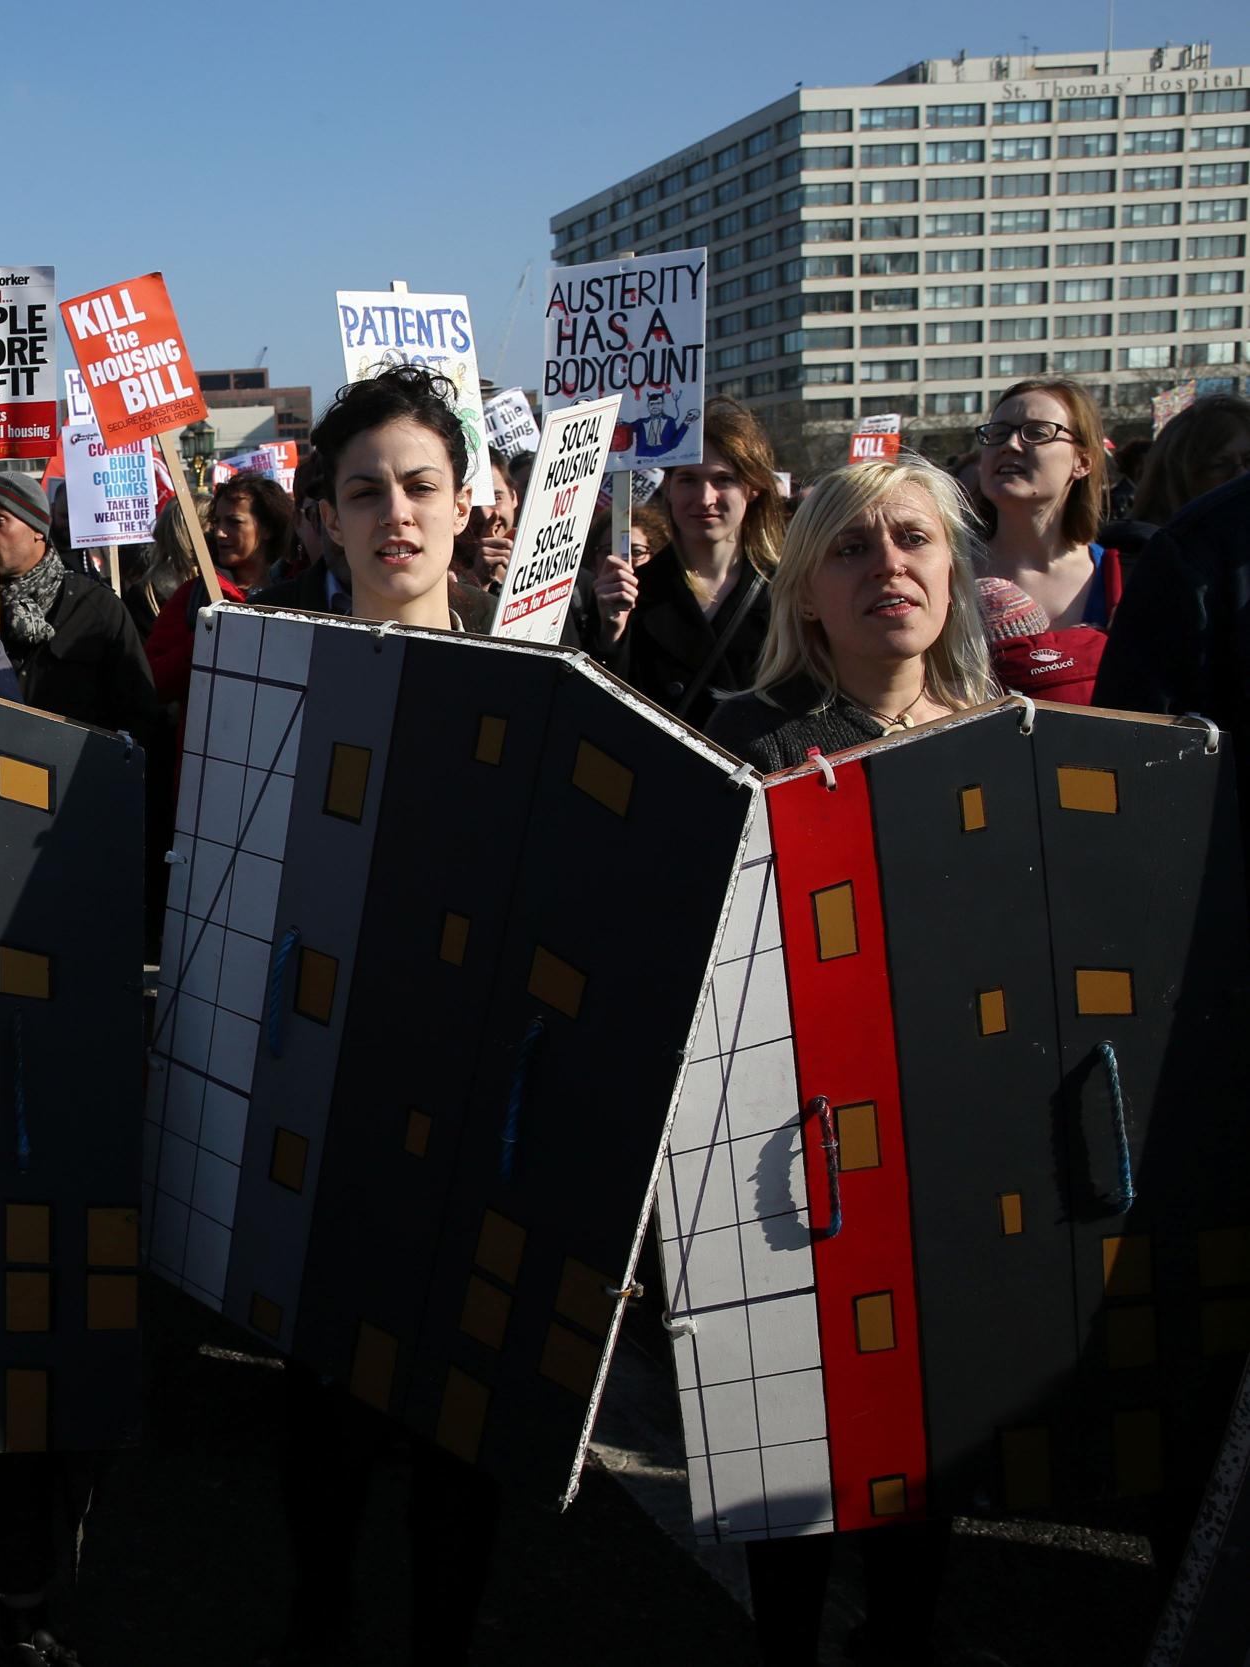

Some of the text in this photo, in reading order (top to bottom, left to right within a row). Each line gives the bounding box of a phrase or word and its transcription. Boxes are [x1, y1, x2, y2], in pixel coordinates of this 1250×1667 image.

[1002, 83, 1027, 99] St.
[1142, 67, 1243, 93] Hospital
[546, 262, 705, 317] AUSTERITY
[69, 289, 146, 340] KILL
[340, 304, 471, 353] PATIENTS
[106, 330, 140, 353] the
[556, 307, 674, 356] HAS A
[87, 338, 181, 388] HOUSING
[544, 344, 704, 396] BODYCOUNT
[118, 364, 194, 415] BILL
[8, 424, 50, 439] housing
[107, 399, 197, 432] SECURE HOMES FOR ALL
[139, 406, 200, 431] CONTROL RENTS
[500, 406, 524, 425] the
[487, 419, 534, 447] ousing
[559, 415, 602, 454] SOCIAL
[853, 437, 885, 457] KILL
[93, 469, 147, 486] COUNCIL
[110, 455, 146, 470] BUILD
[544, 447, 601, 491] HOUSING
[104, 482, 148, 498] HOMES
[106, 498, 149, 511] TAKE THE
[551, 485, 579, 520] NOT
[94, 508, 150, 523] WEALTH OFF
[118, 520, 151, 532] THE 1%
[533, 516, 576, 558] SOCIAL
[512, 543, 581, 595] CLEANSING
[504, 583, 570, 622] Unite for homes
